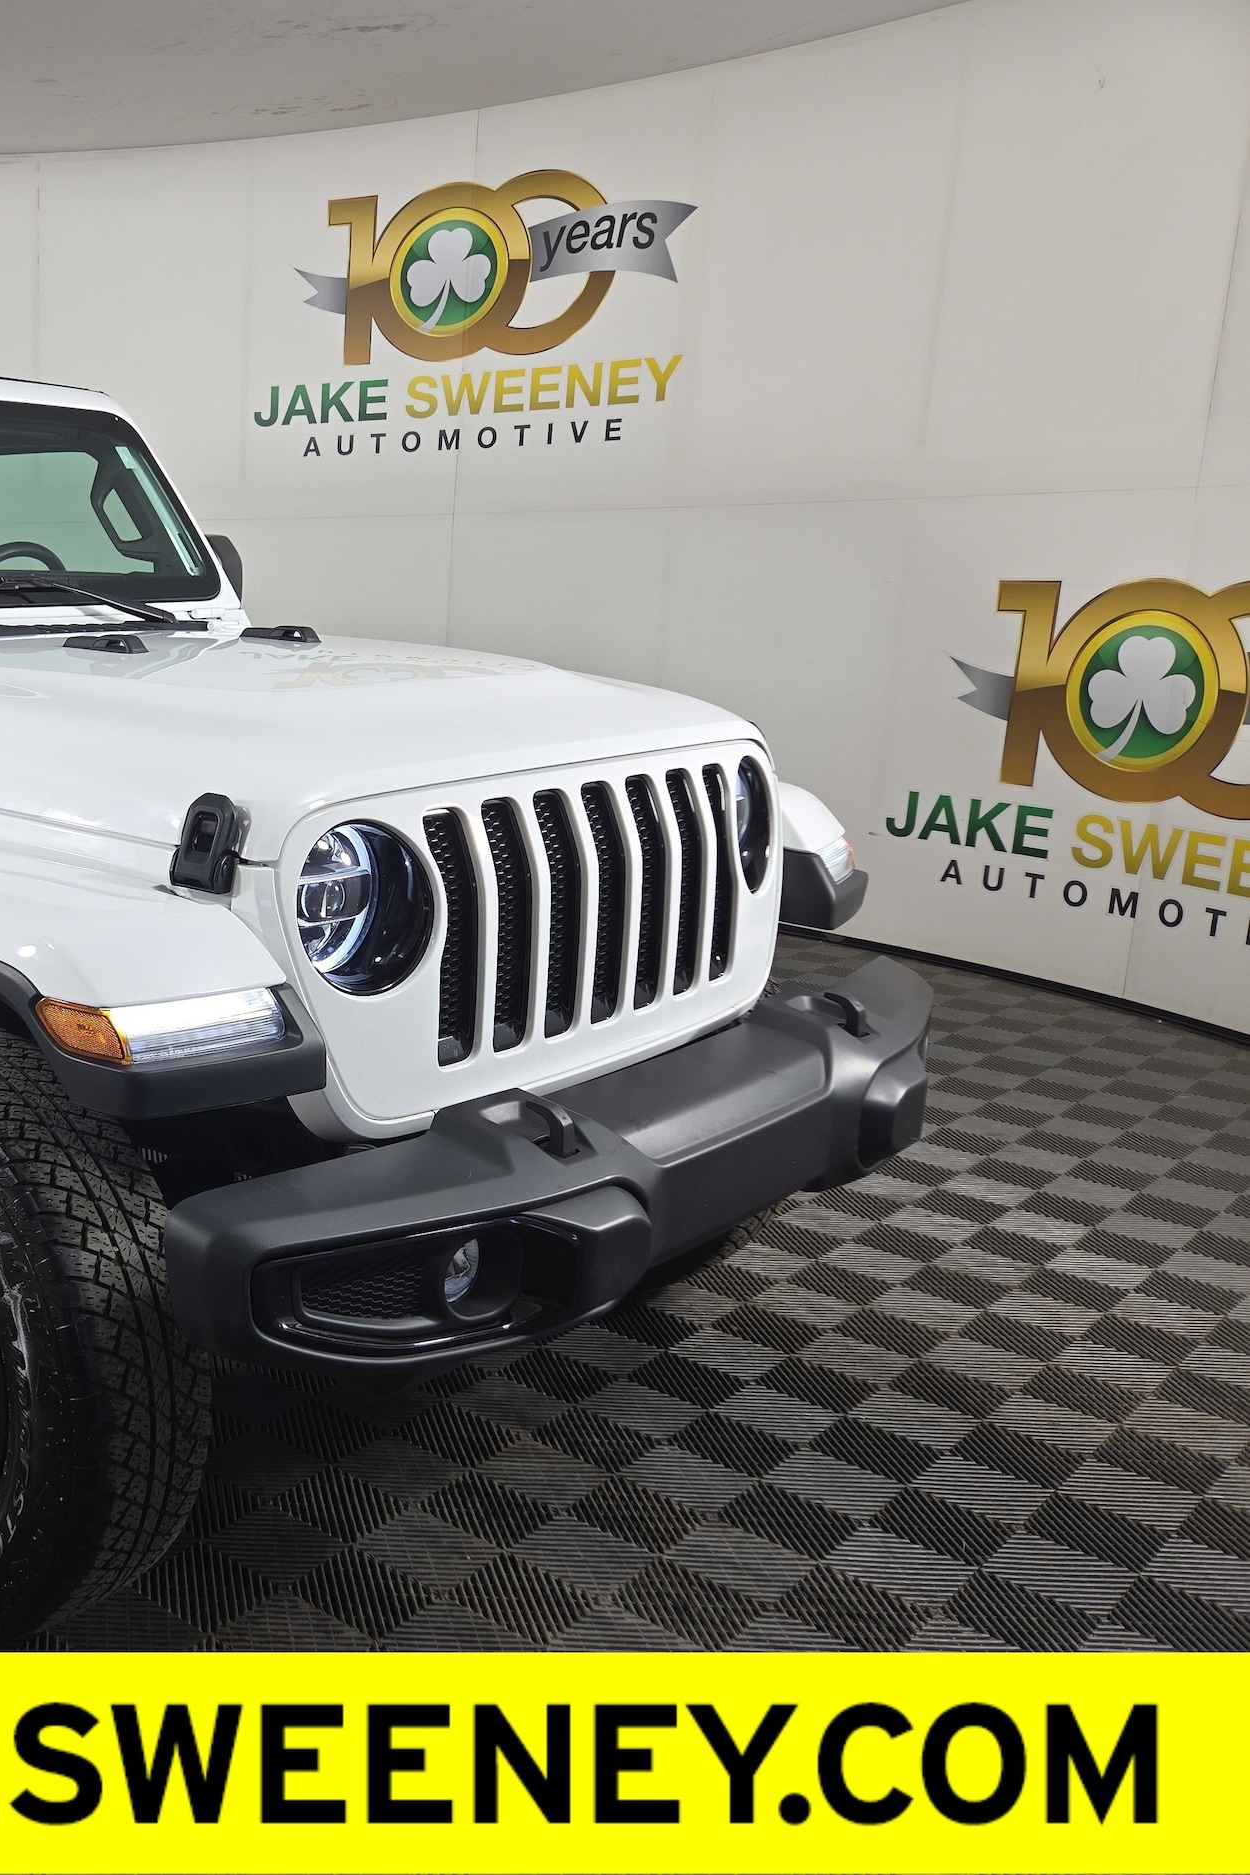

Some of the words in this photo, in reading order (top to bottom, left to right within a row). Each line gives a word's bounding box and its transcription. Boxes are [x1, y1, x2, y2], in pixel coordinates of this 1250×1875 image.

[327, 168, 617, 366] 100
[539, 210, 658, 272] years
[253, 378, 389, 427] JAKE
[404, 353, 685, 420] SWEENEY
[303, 417, 623, 458] AUTOMOTIVE
[885, 790, 1054, 860] JAKE
